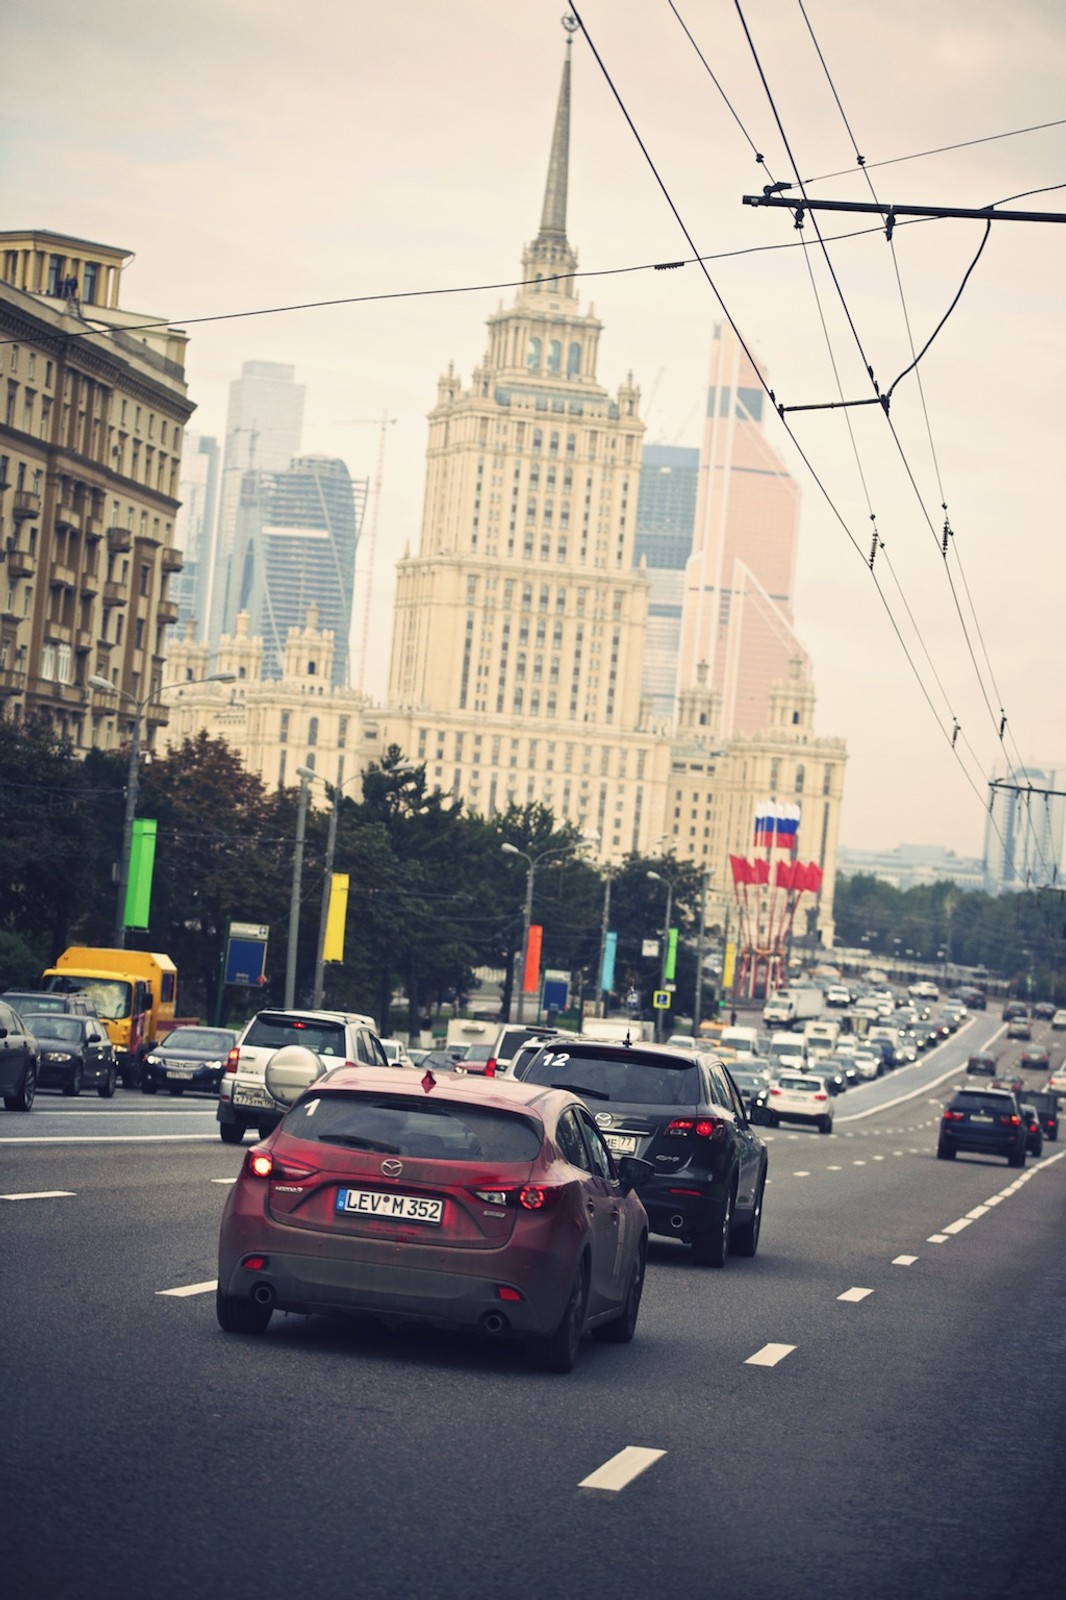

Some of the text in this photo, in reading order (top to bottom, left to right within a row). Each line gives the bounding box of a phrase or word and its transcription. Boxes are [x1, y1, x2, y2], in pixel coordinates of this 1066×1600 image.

[543, 1052, 570, 1067] 12
[304, 1098, 321, 1117] 1
[621, 1135, 632, 1147] 77
[346, 1191, 382, 1211] LEV
[392, 1197, 405, 1214] M
[407, 1199, 440, 1219] 352
